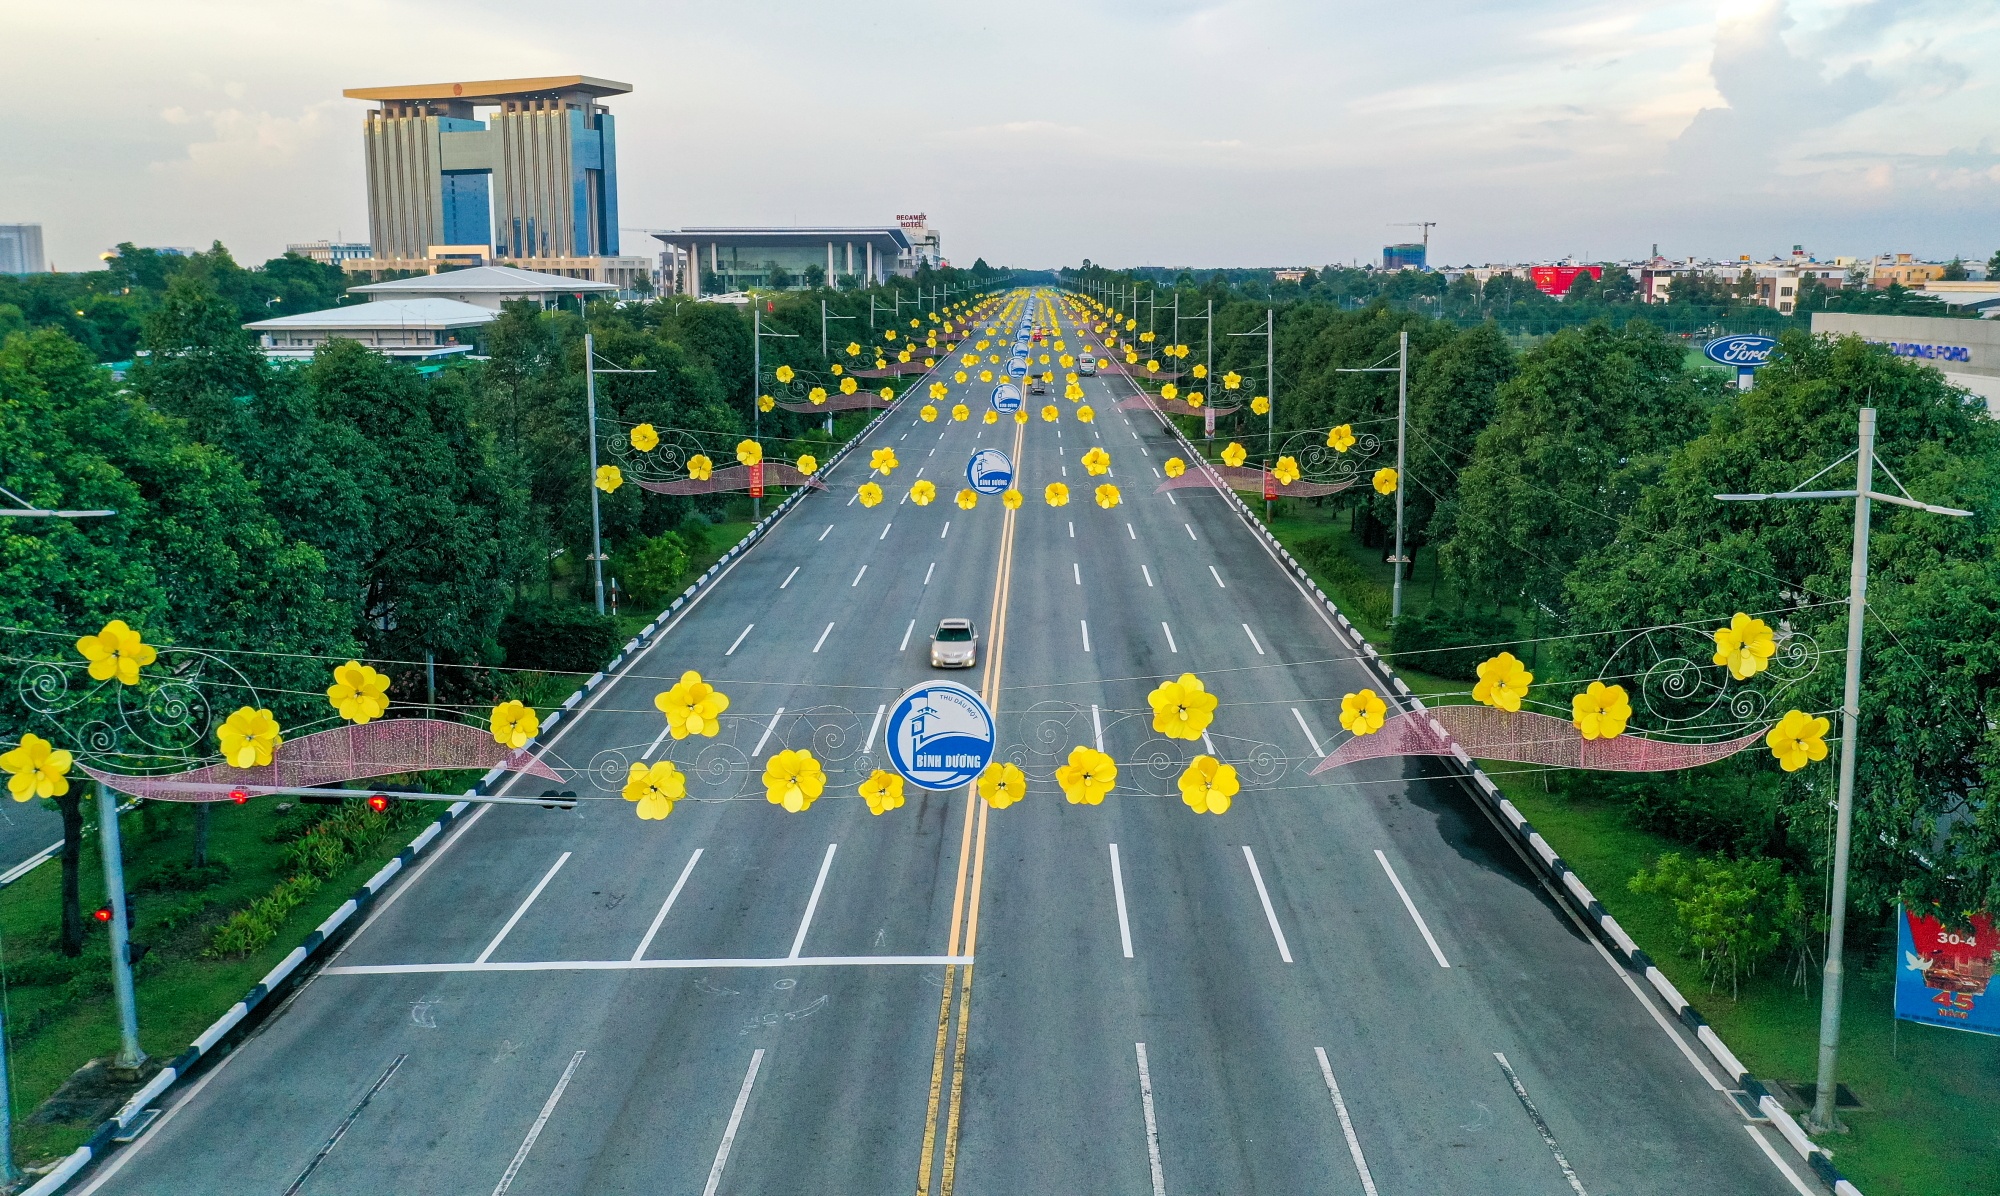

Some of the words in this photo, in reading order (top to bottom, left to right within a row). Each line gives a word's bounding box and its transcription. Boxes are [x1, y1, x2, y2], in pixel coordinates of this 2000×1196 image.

[1723, 341, 1774, 361] Ford
[1937, 345, 1969, 362] FORD
[916, 752, 941, 768] BÌNH
[945, 753, 981, 768] DƯƠNG
[1937, 932, 1977, 947] 30-4
[1931, 990, 1975, 1011] 45
